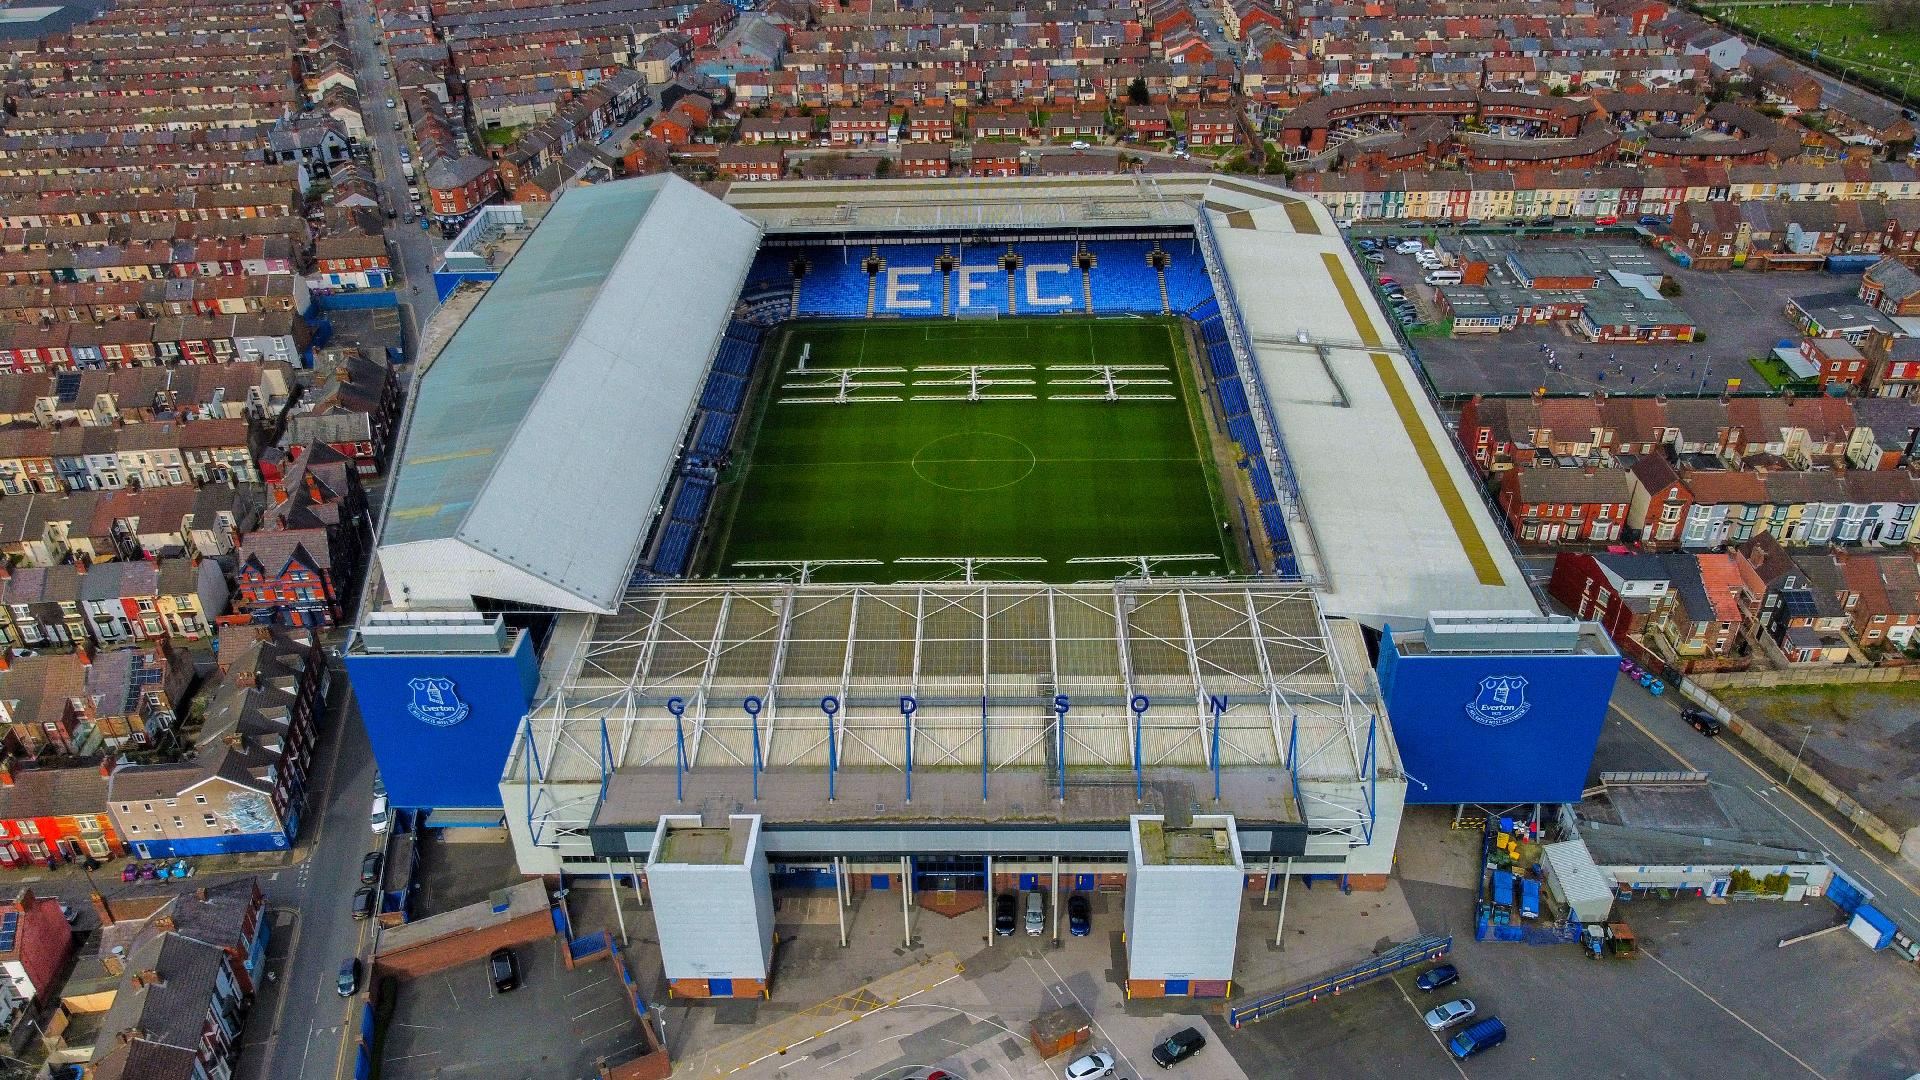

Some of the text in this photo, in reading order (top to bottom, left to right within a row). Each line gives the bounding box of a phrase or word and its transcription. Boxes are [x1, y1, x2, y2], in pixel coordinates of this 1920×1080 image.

[885, 263, 1073, 308] EFC
[422, 704, 455, 712] Everton
[667, 694, 1228, 716] GOODISON
